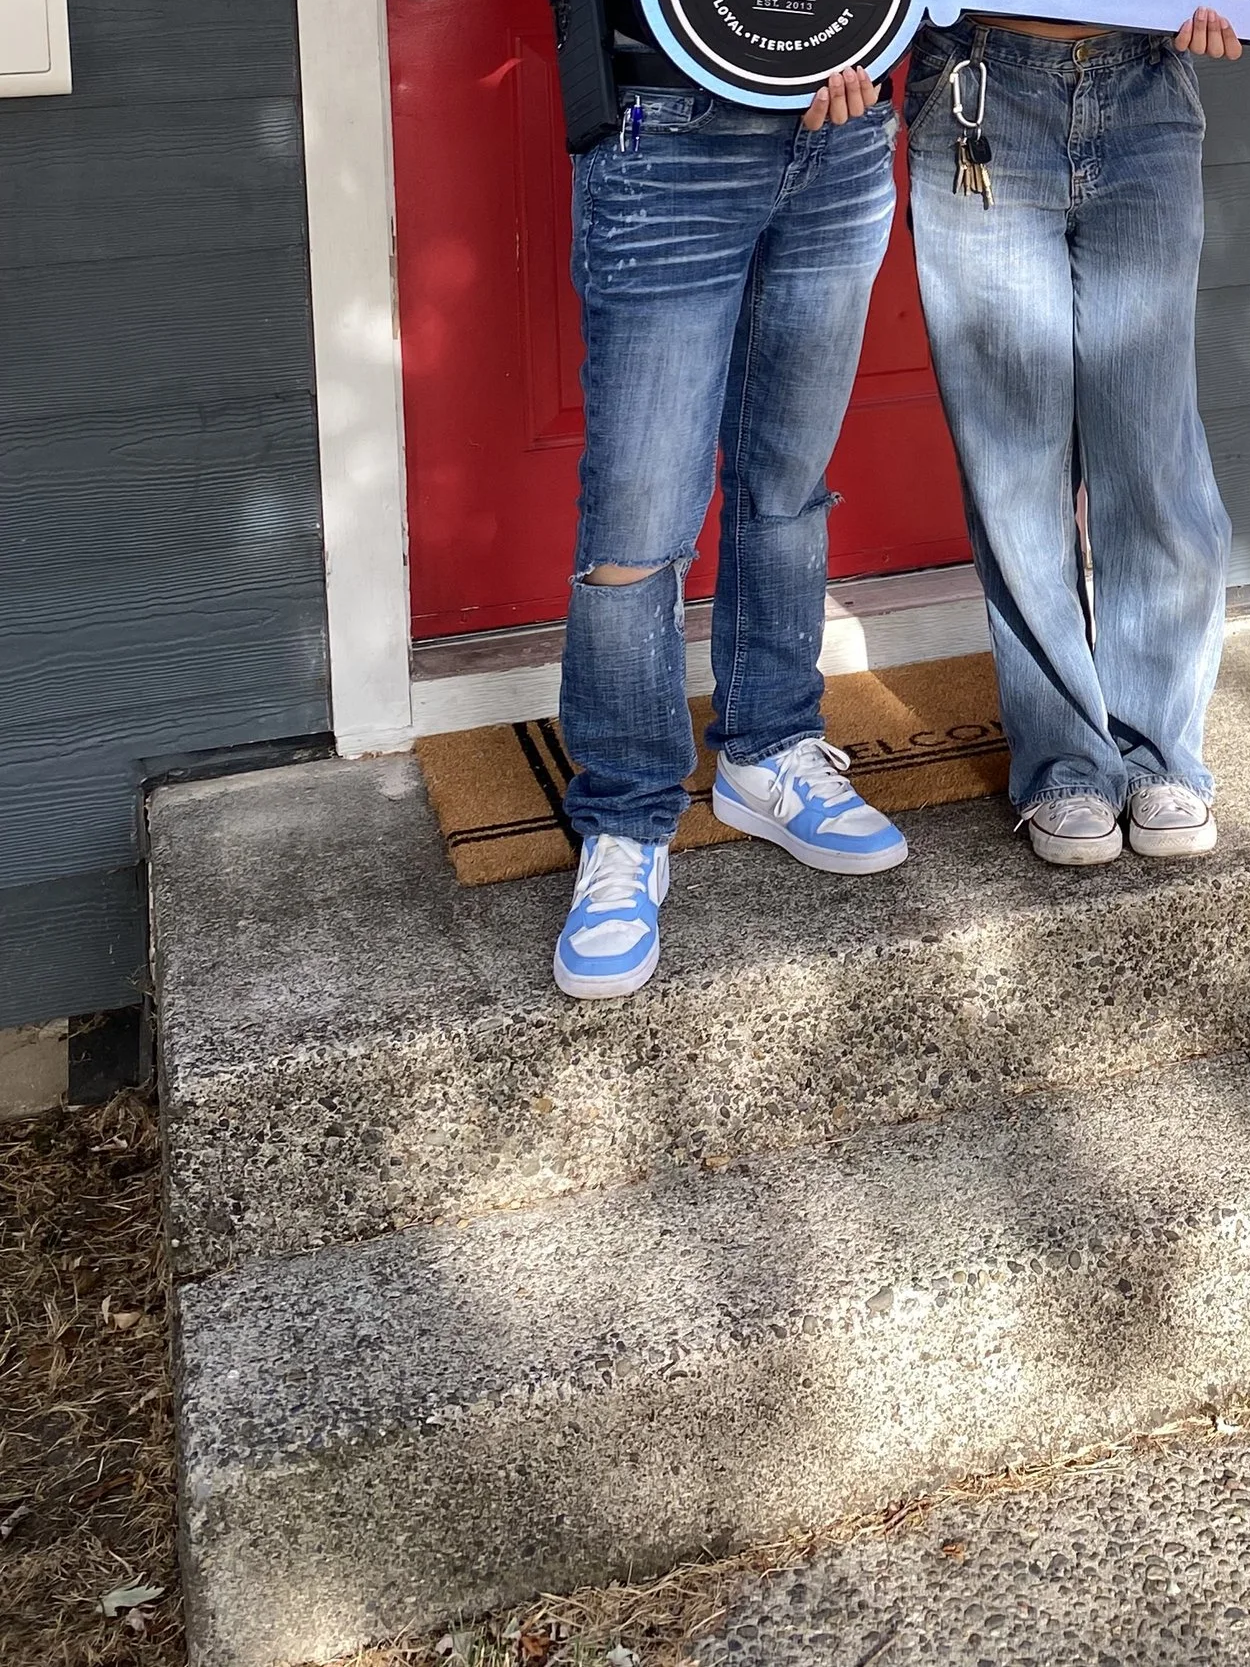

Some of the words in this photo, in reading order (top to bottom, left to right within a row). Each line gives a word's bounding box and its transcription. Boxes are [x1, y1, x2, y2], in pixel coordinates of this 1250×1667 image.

[785, 1, 814, 11] 2013
[750, 34, 803, 52] FIERCE
[808, 8, 855, 47] HONEST
[842, 720, 1004, 760] ELCO
